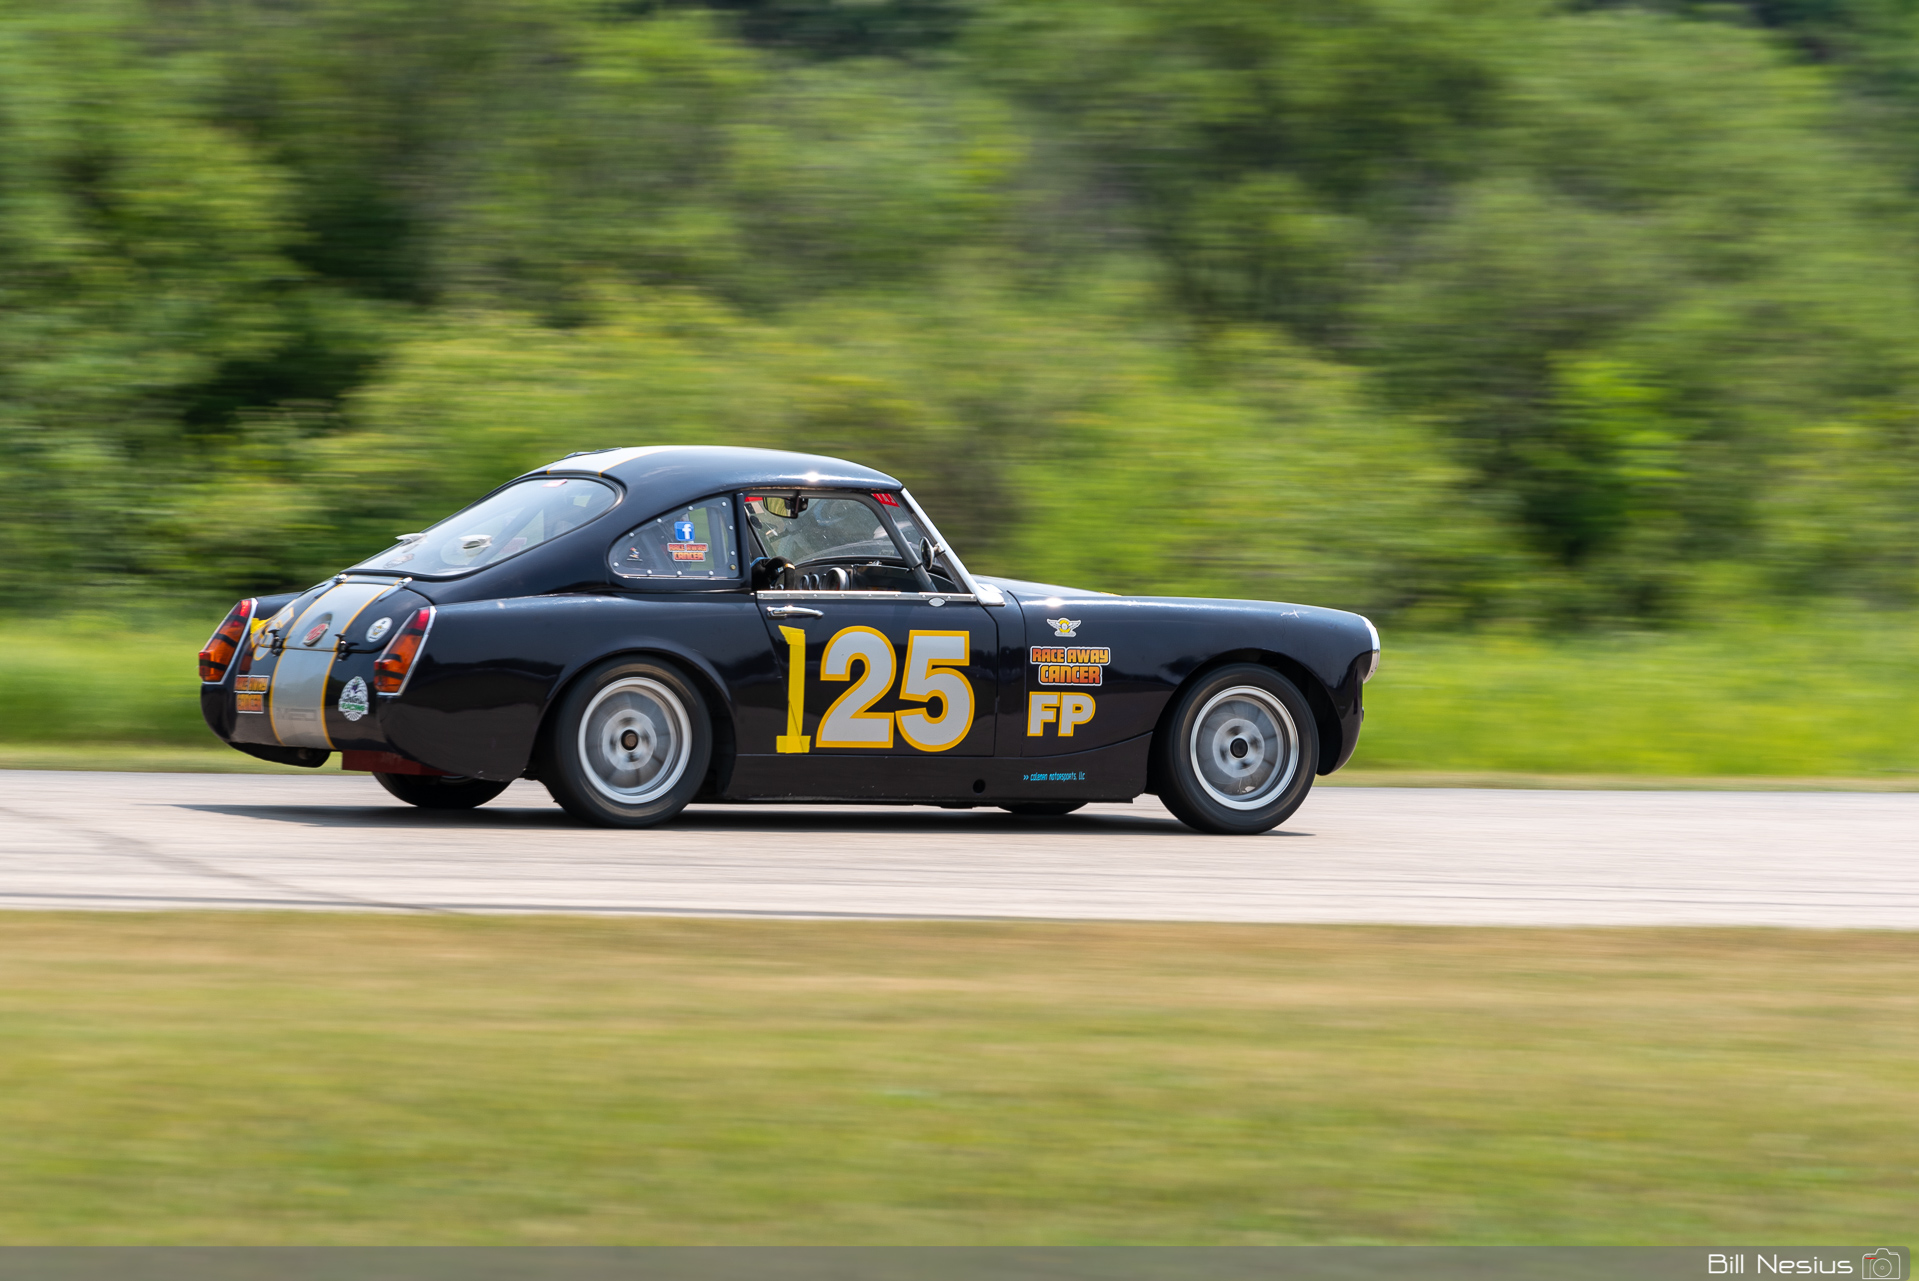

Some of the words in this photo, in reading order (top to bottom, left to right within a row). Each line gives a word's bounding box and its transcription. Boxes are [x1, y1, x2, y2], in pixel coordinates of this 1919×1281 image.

[1031, 647, 1065, 663] RACE
[1066, 648, 1109, 664] AWAY
[778, 625, 975, 753] 125
[1040, 665, 1101, 685] CANCER
[1027, 691, 1096, 737] FP
